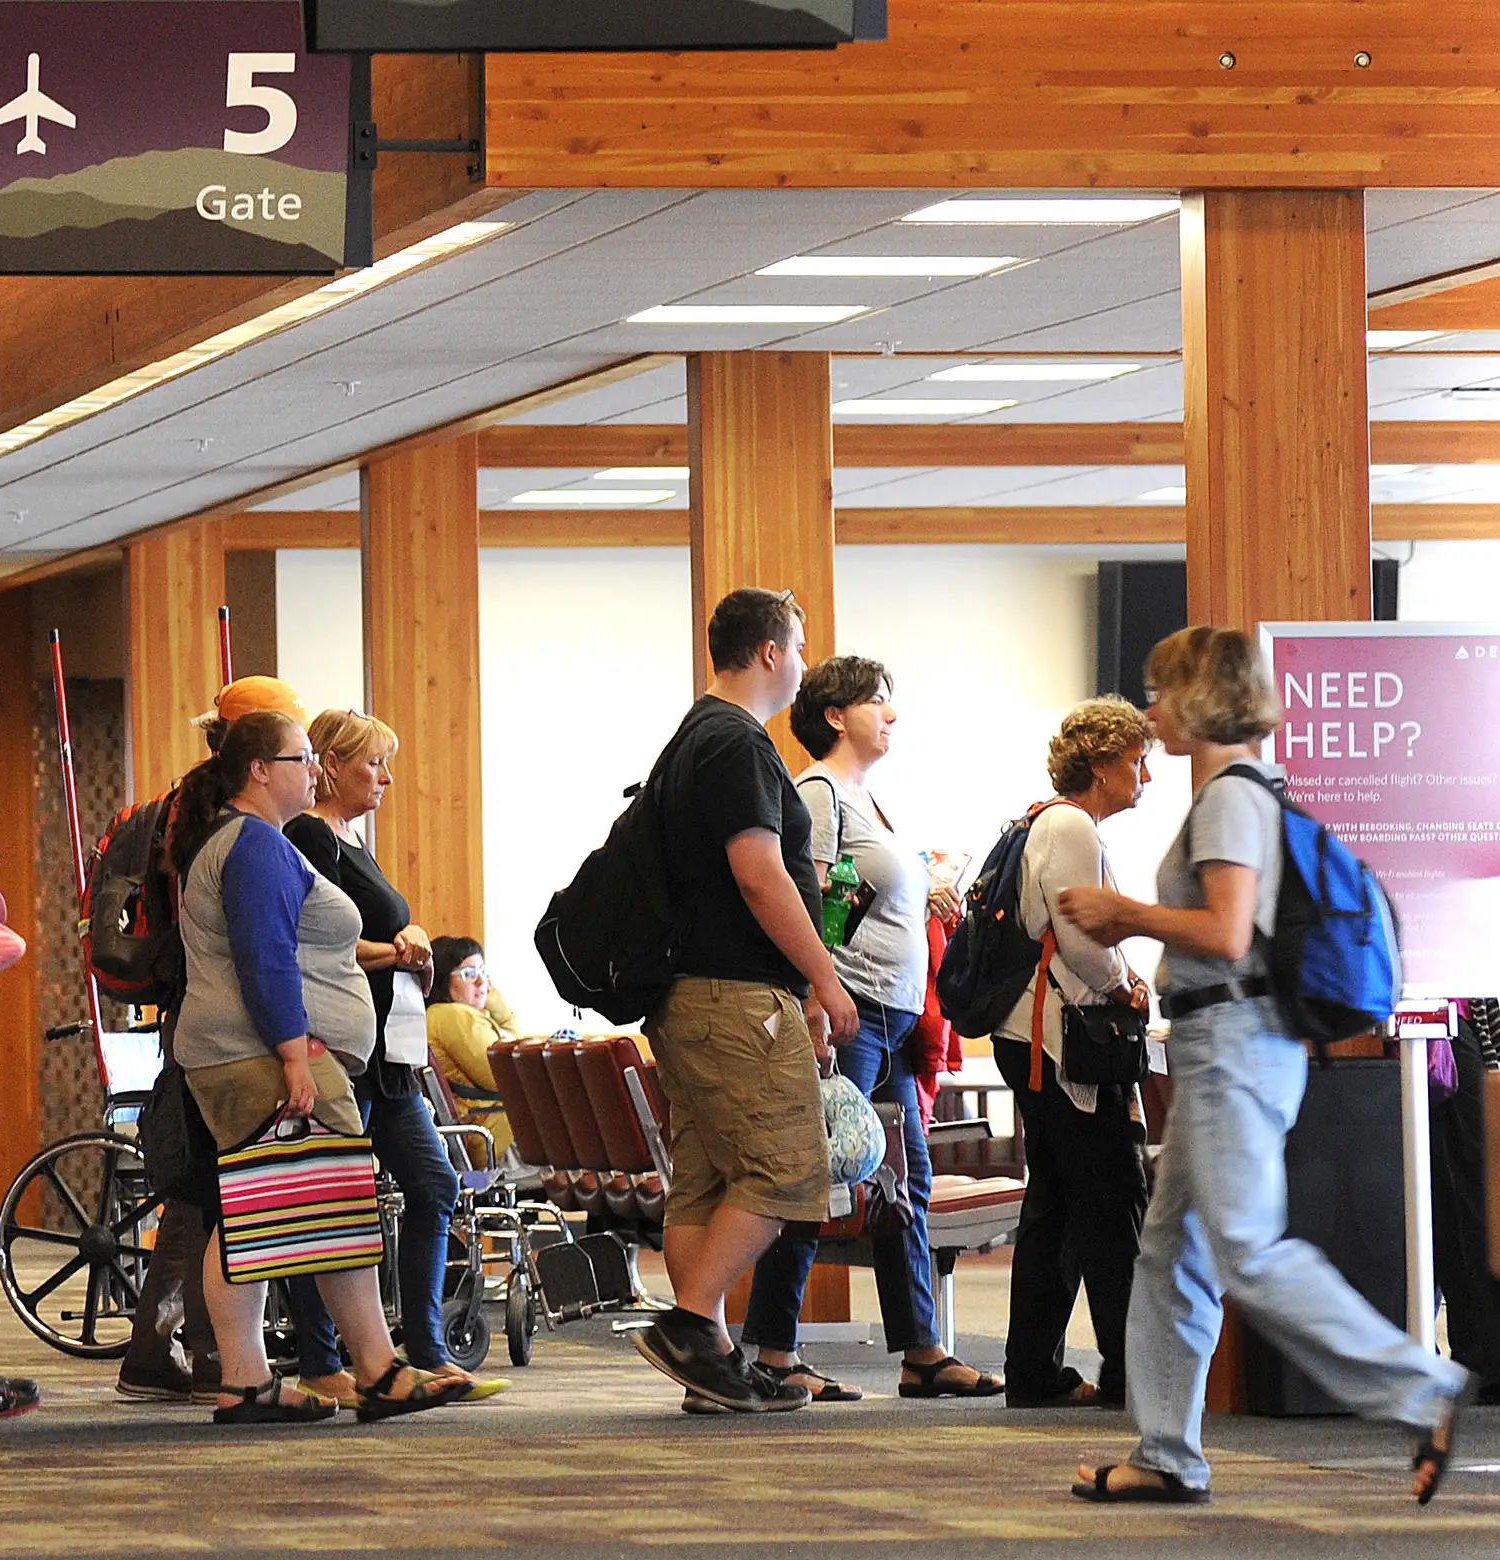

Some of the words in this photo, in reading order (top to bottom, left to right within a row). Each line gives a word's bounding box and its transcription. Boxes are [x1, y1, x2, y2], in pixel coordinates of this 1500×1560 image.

[223, 52, 298, 155] 5
[195, 184, 303, 221] Gate
[1284, 671, 1404, 709] NEED
[1285, 721, 1423, 759] HELP?
[1283, 773, 1322, 787] Missed
[1324, 777, 1336, 787] or
[1338, 773, 1389, 787] cancelled
[1390, 773, 1423, 788] flight?
[1425, 773, 1457, 786] Other
[1460, 772, 1499, 786] issues?
[1283, 790, 1315, 803] We're
[1317, 790, 1341, 802] here
[1344, 791, 1355, 802] to
[1357, 789, 1383, 804] help.
[1332, 822, 1358, 832] WITH
[1359, 822, 1414, 834] REBOOKING,
[1416, 821, 1465, 832] CHANGING
[1467, 821, 1494, 831] SEATS
[1336, 833, 1358, 843] NEW
[1359, 833, 1408, 843] BOARDING
[1409, 832, 1436, 842] PASS?
[1438, 832, 1468, 842] OTHER
[1469, 831, 1500, 843] QUEST
